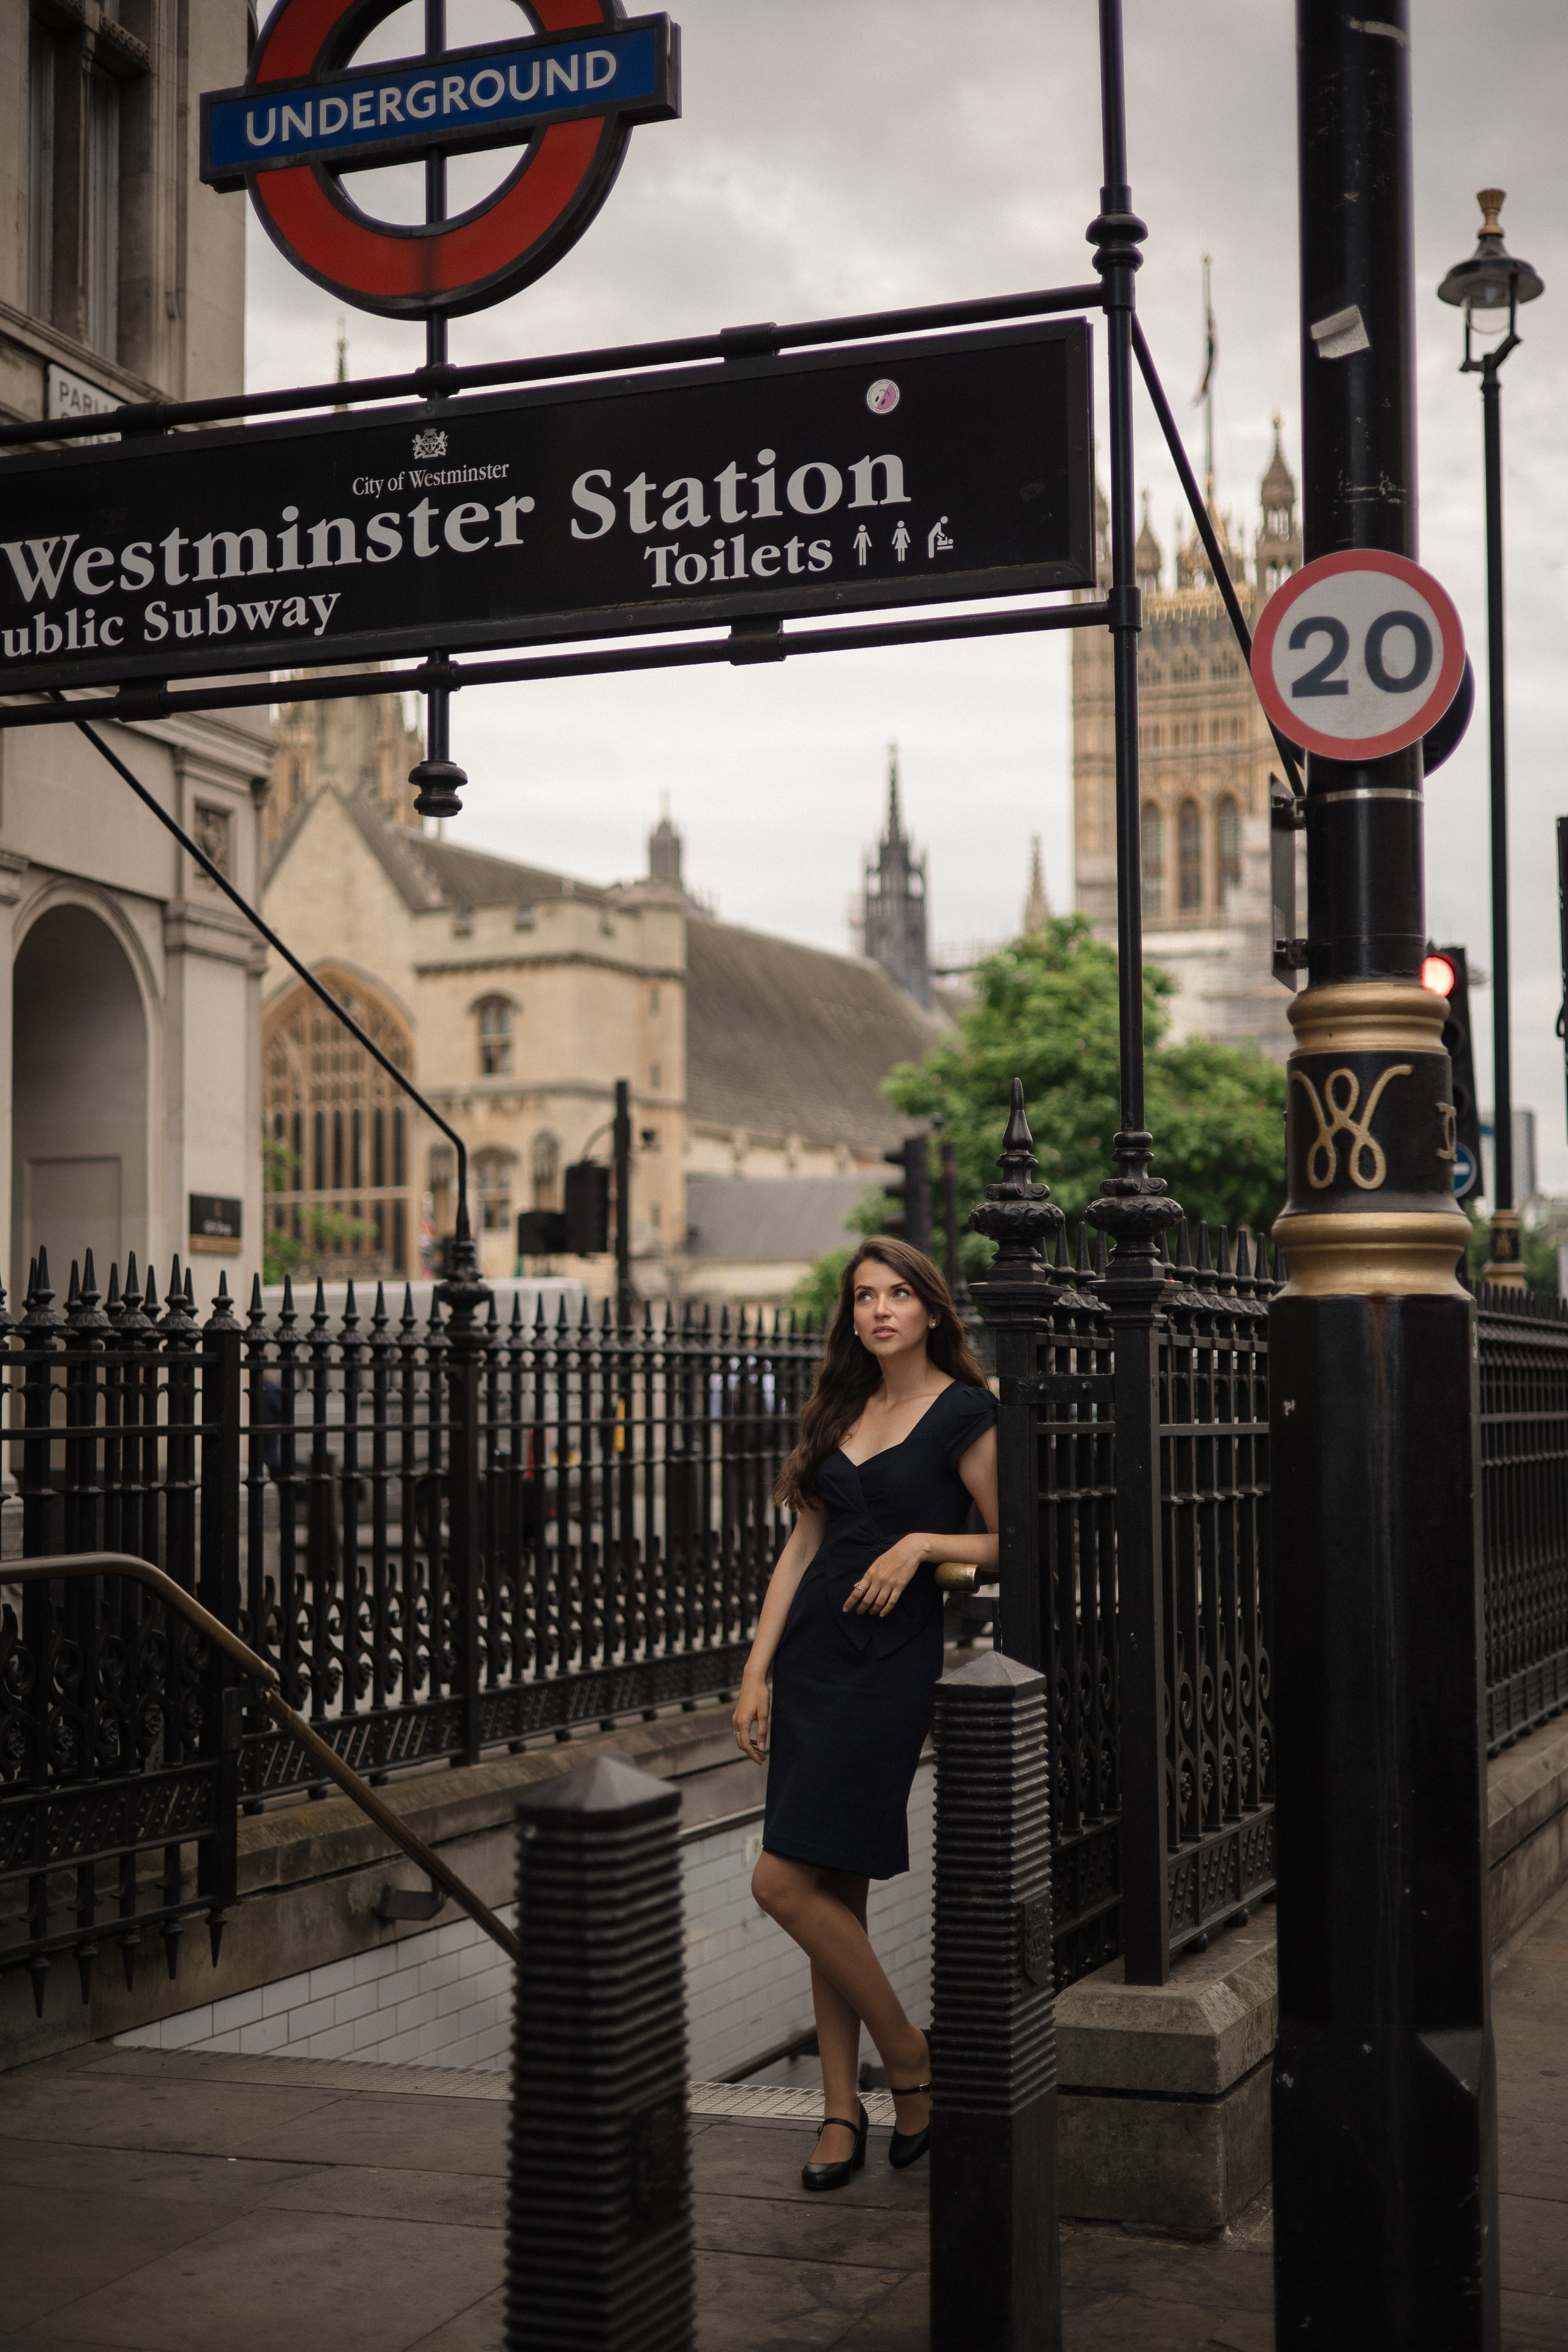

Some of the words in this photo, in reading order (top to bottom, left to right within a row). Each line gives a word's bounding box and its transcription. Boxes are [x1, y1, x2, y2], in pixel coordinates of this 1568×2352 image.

[247, 50, 617, 146] UNDERGROUND
[353, 477, 385, 499] City
[387, 471, 405, 491] of
[408, 464, 509, 488] Westminster
[0, 495, 535, 602] Westminster
[571, 448, 911, 540] Station
[643, 533, 833, 588] Toilets
[1, 601, 124, 657] ublic
[144, 592, 341, 641] Subway
[1289, 610, 1433, 698] 20
